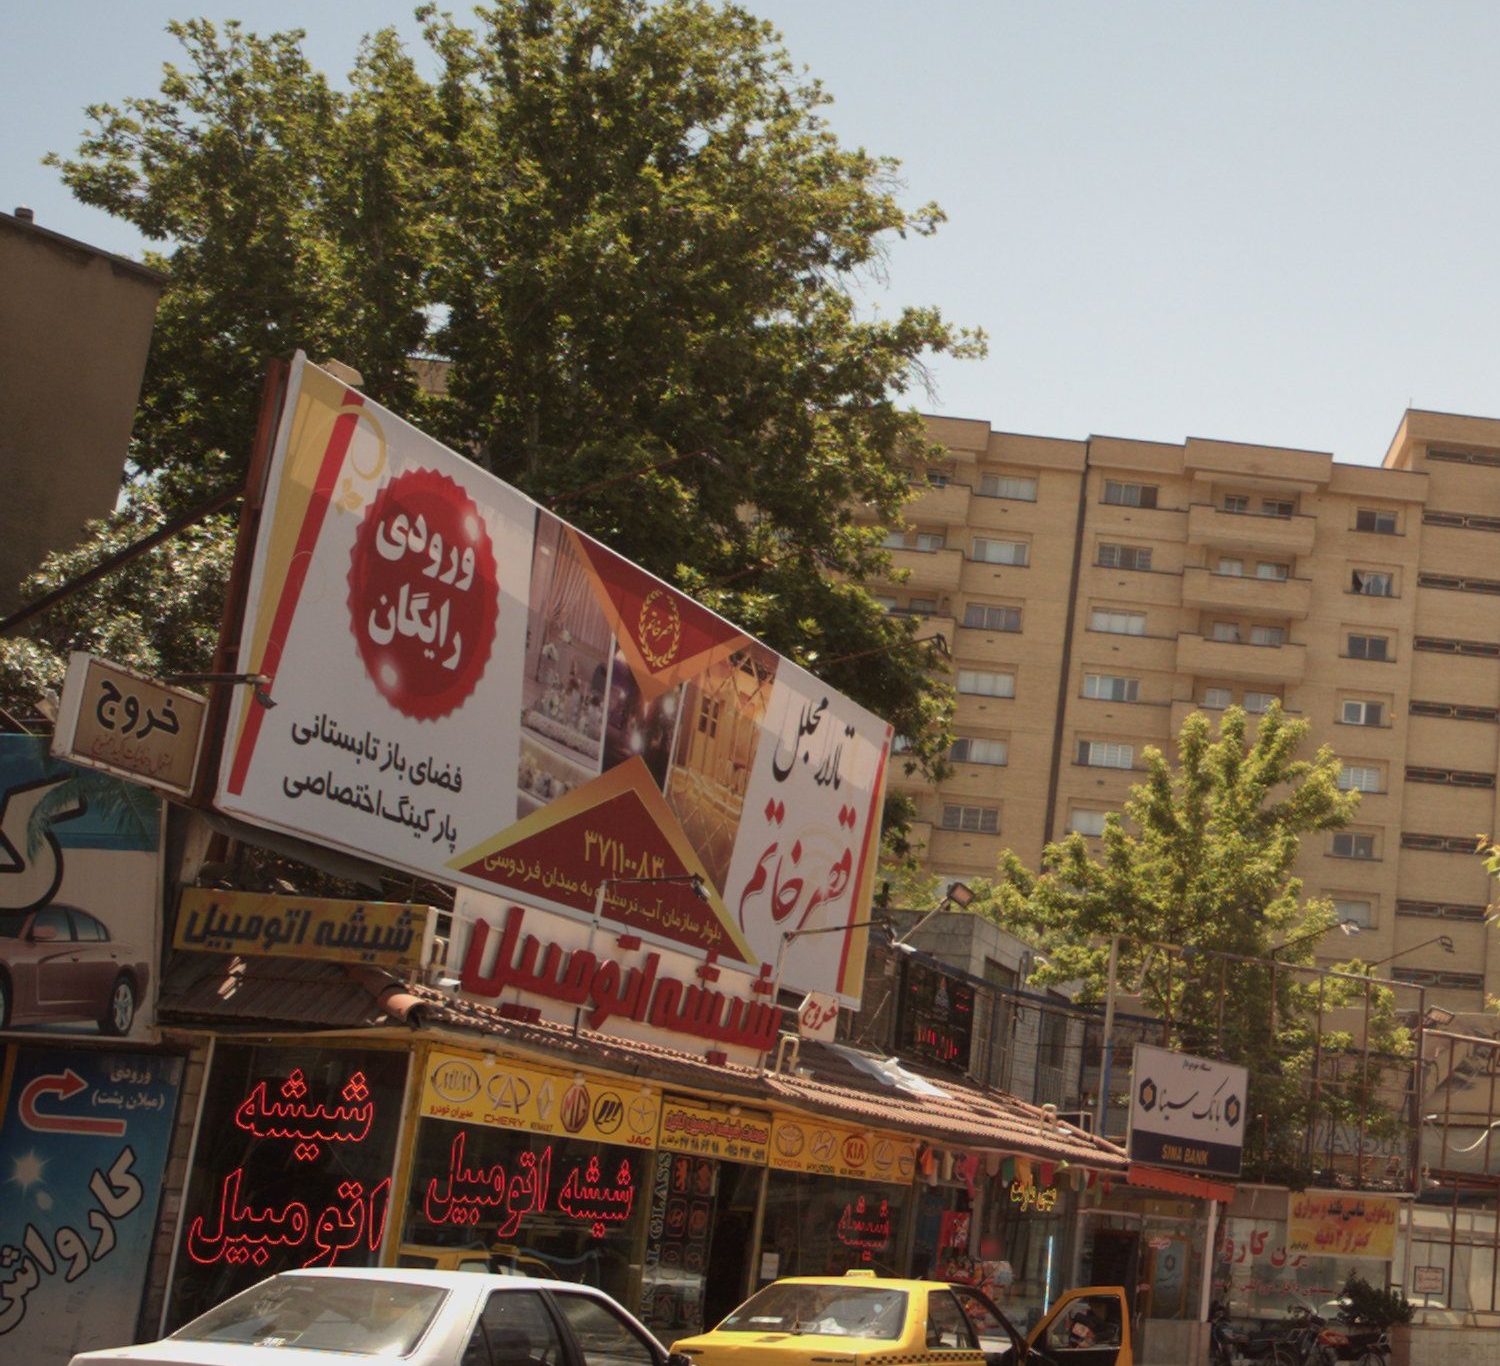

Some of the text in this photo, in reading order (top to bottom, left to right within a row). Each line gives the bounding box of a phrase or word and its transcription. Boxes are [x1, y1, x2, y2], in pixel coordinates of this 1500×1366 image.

[375, 514, 476, 592] ورودی
[368, 583, 462, 671] رایگان
[96, 680, 180, 740] خروج
[291, 713, 463, 793] فضای باز تابستانی
[814, 724, 856, 791] تالار
[283, 770, 457, 854] پارکینگ اختصاصی
[483, 854, 541, 883] فردوسی
[541, 866, 578, 896] میدان
[580, 881, 596, 899] به
[738, 796, 804, 935] خاتم
[183, 902, 417, 962] شیشه اتومبیل
[662, 908, 700, 933] سازمان
[459, 906, 784, 1067] شیشه اتومبیل
[801, 998, 839, 1031] خروج
[235, 1068, 374, 1162] شیشه
[483, 1112, 526, 1128] CHERY
[1158, 1075, 1230, 1131] بانک سینا
[626, 1135, 652, 1147] JAC
[846, 1141, 865, 1161] KIA
[1161, 1143, 1210, 1165] SINA BANK
[425, 1131, 635, 1239] شیشه اتومبیل
[188, 1167, 392, 1270] اتومبیل
[837, 1194, 890, 1262] شیشه
